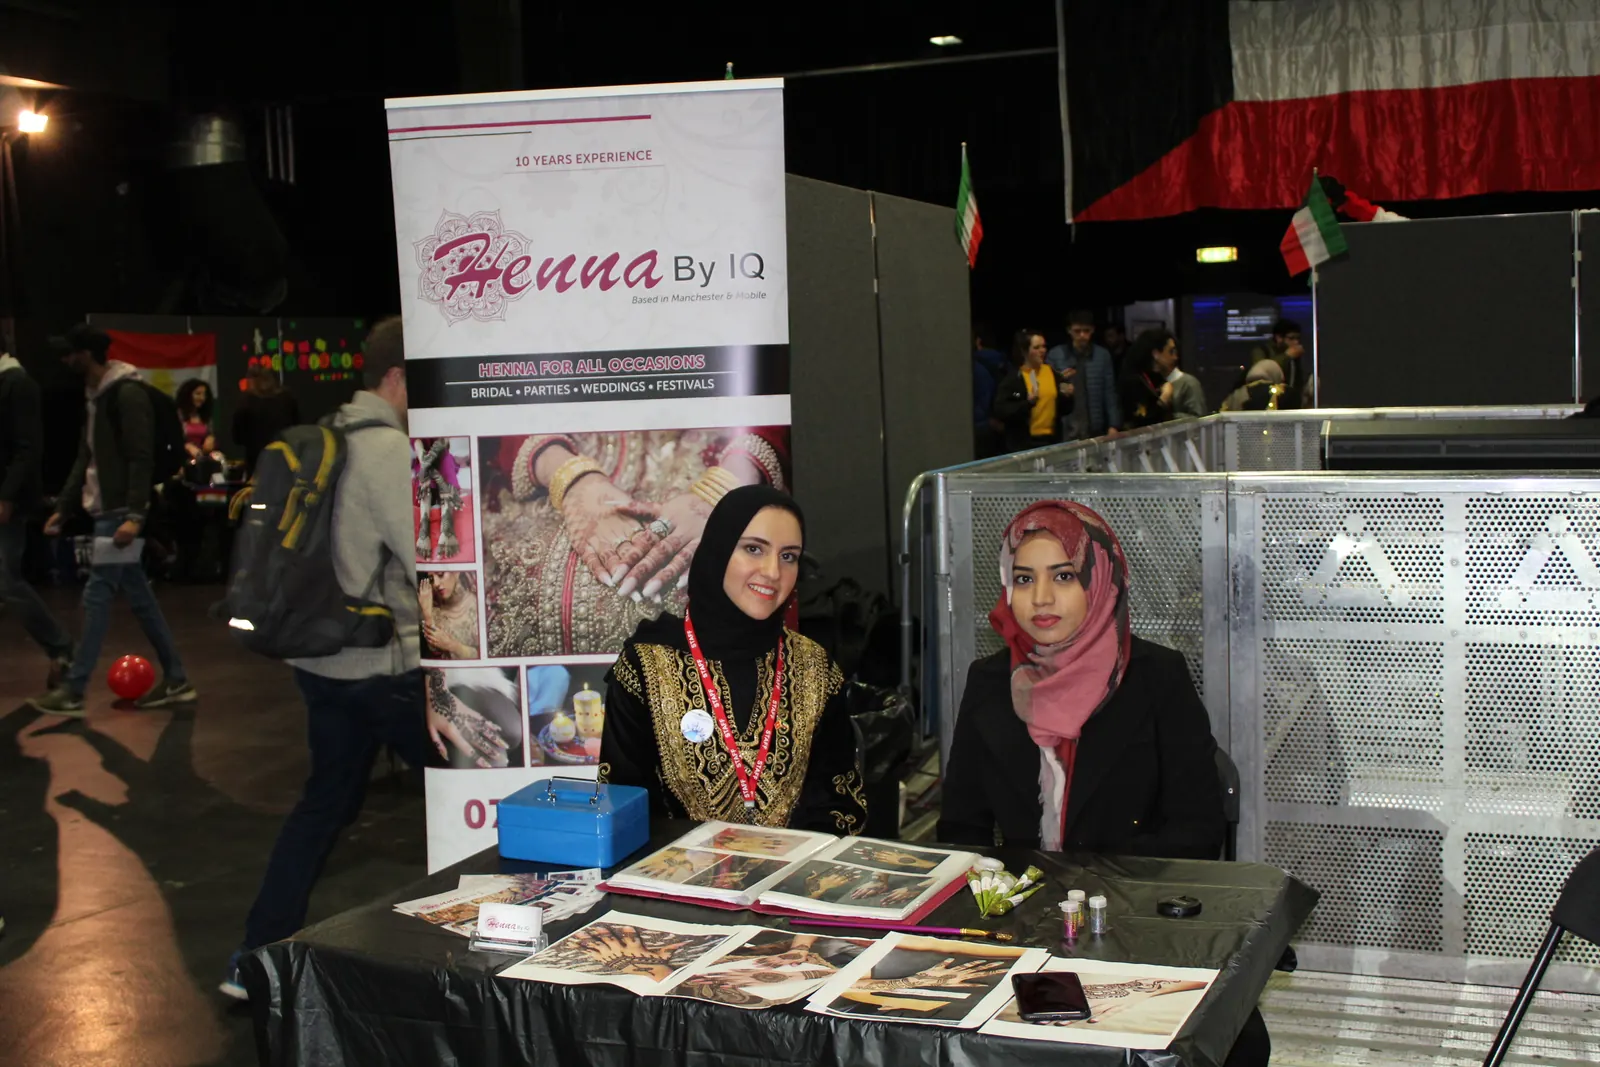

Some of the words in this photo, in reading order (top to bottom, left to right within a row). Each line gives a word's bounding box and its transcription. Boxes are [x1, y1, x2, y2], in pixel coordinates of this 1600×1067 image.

[515, 156, 530, 167] 10
[533, 154, 573, 166] YEARS
[576, 150, 653, 165] EXPERIENCE
[433, 232, 664, 301] Henna
[673, 255, 716, 288] By
[729, 252, 765, 280] IQ
[632, 295, 659, 304] Based
[660, 295, 669, 303] in
[671, 292, 724, 303] Manchester
[726, 292, 734, 300] &
[735, 291, 767, 300] Mobile
[479, 361, 537, 378] HENNA
[540, 359, 573, 375] FOR
[576, 358, 606, 374] ALL
[608, 354, 706, 372] OCCASIONS
[471, 387, 513, 399] BRIDAL
[524, 384, 571, 396] PARTIES
[581, 381, 646, 394] WEDDINGS
[656, 379, 715, 391] FESTIVALS
[686, 630, 697, 649] STAFF
[696, 659, 708, 679] STAFF
[707, 688, 720, 709] STAFF
[769, 699, 778, 719] STAFF
[719, 718, 732, 738] STAFF
[762, 729, 772, 751] STAFF
[730, 748, 742, 769] STAFF
[752, 759, 763, 781] STAFF
[740, 779, 751, 799] STAFF
[486, 917, 517, 931] Henna
